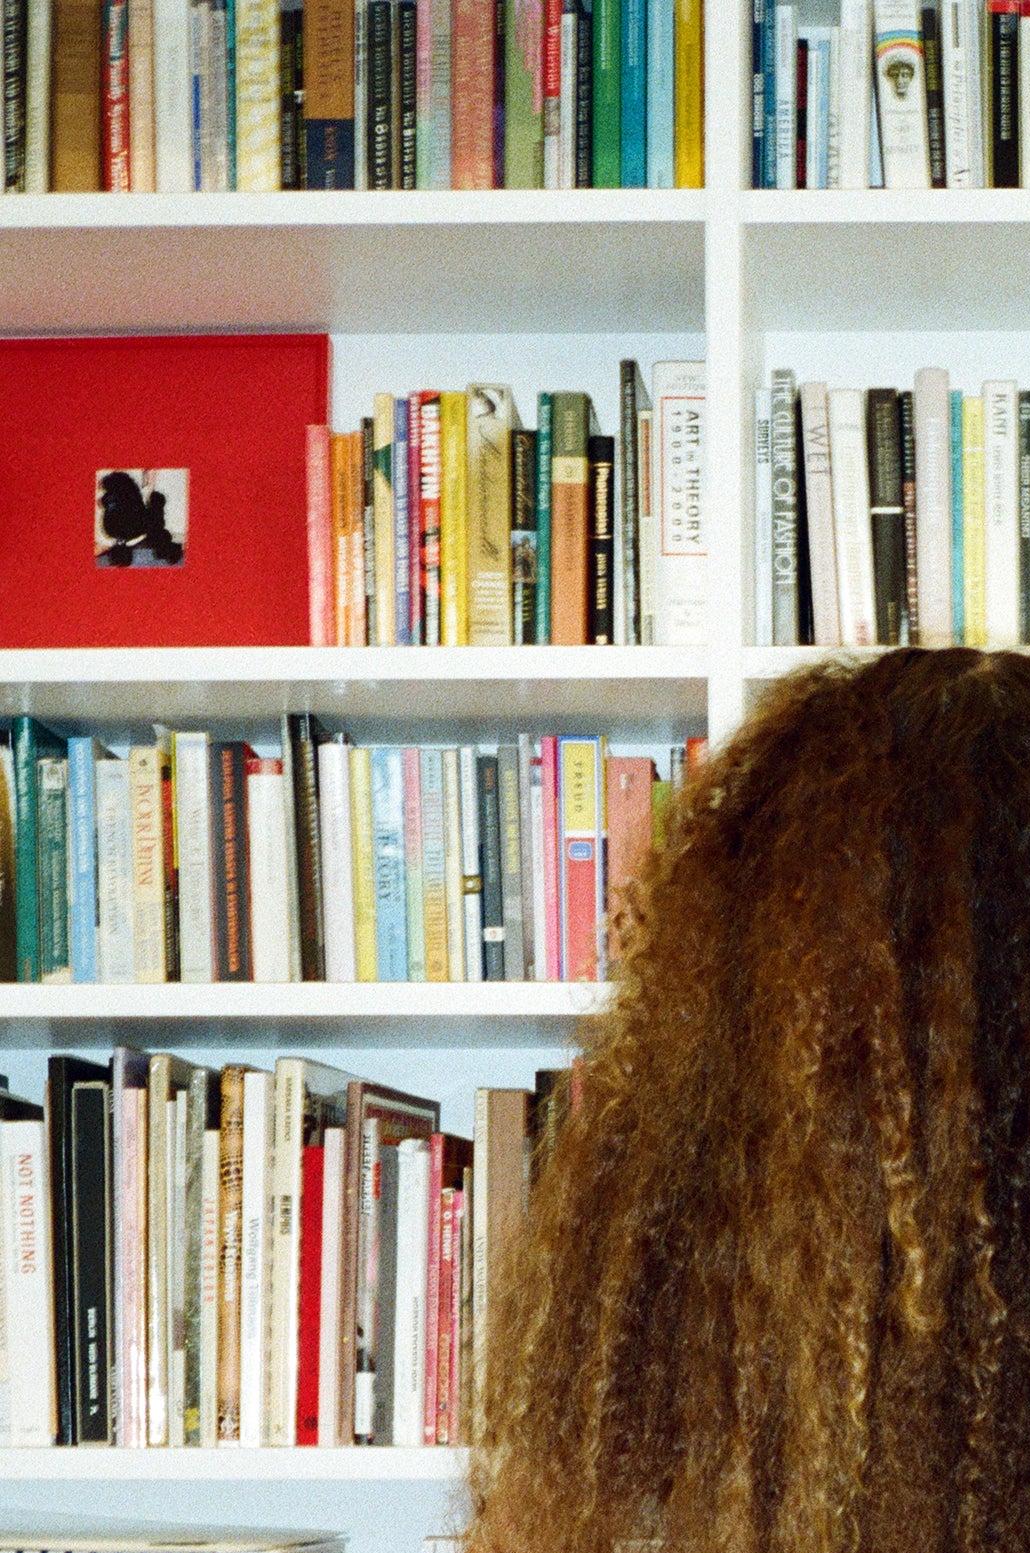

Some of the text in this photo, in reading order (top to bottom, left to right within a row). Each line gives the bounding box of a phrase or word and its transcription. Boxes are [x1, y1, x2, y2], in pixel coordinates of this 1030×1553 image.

[547, 25, 559, 90] Winterson
[107, 104, 124, 153] Systems
[778, 99, 790, 159] AMERICA
[993, 394, 1007, 438] KANT
[421, 405, 438, 499] BAKHTIN
[671, 411, 683, 544] 1900-2000
[686, 411, 701, 545] ART THEORY
[775, 478, 797, 505] OF
[775, 512, 797, 585] FASHION
[573, 762, 584, 815] FREUD
[17, 1153, 38, 1276] NOT NOTHING
[280, 1195, 293, 1236] MEMPHIS
[442, 1225, 452, 1262] HENRY
[246, 1218, 260, 1279] Wolfgang
